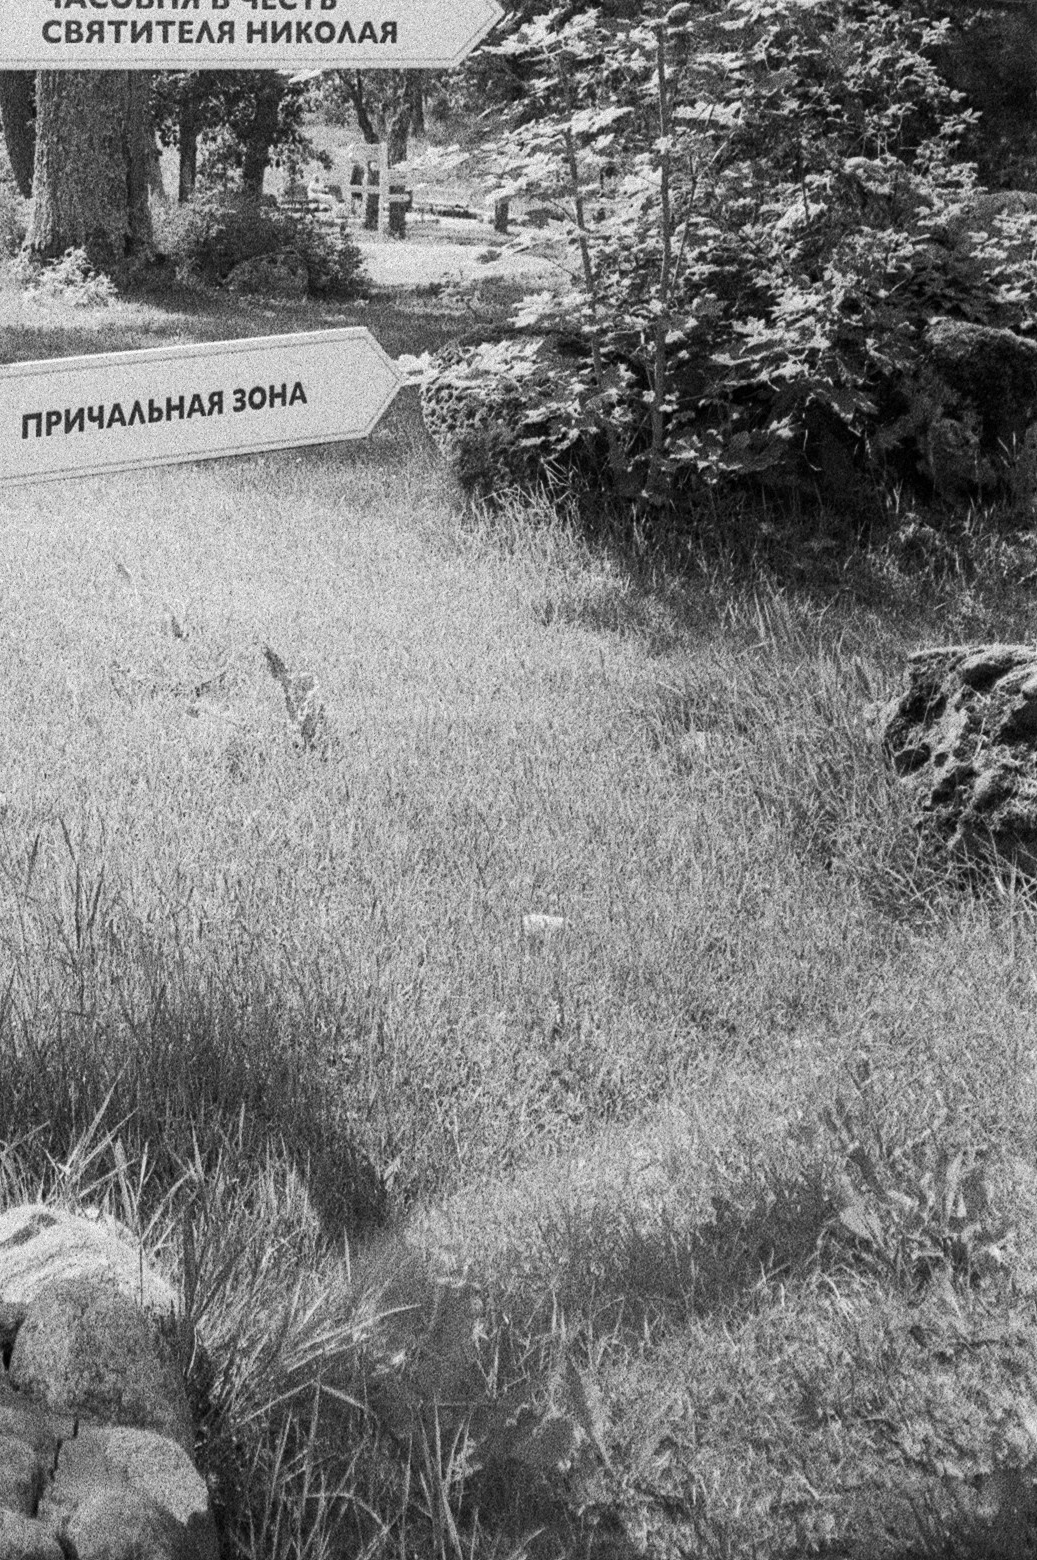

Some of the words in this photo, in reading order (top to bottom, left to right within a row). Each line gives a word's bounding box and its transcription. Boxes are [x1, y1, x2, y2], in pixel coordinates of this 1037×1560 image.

[41, 19, 236, 45] СВЯТИТЕЛЯ
[245, 19, 399, 45] НИКОЛАЯ
[20, 389, 225, 441] ПРИЧАЛЬНАЯ
[232, 380, 309, 414] ЗОНА
